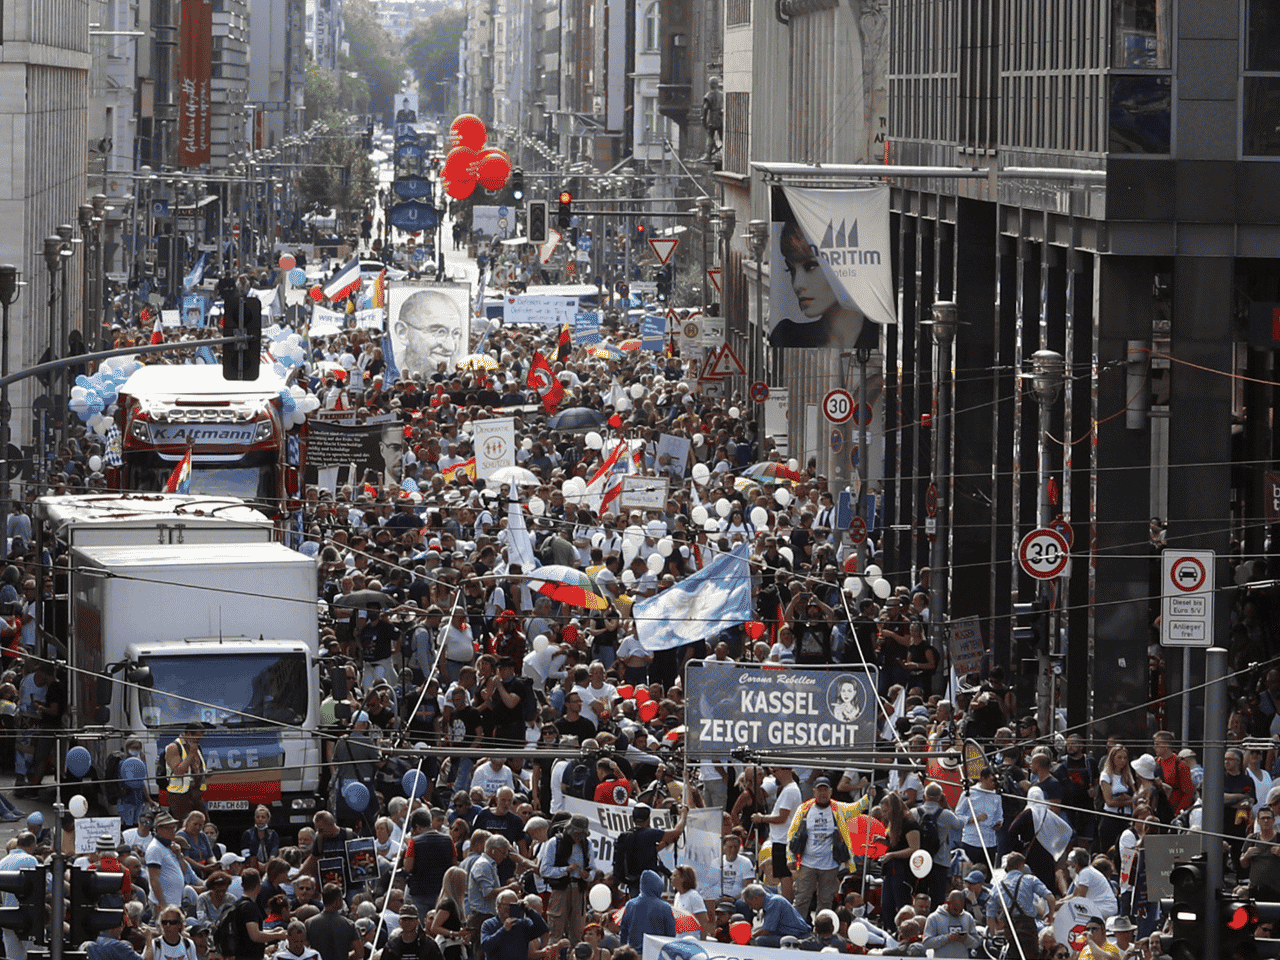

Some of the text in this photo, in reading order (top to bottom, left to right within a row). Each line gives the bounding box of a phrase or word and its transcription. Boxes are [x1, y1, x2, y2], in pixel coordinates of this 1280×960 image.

[829, 398, 848, 414] 30
[1030, 543, 1059, 565] 30
[1173, 623, 1202, 631] Anlieger
[738, 673, 817, 685] Corona Rebellen
[740, 690, 819, 716] KASSEL
[699, 719, 859, 748] ZEIGT GESICHT
[207, 747, 259, 769] ACE
